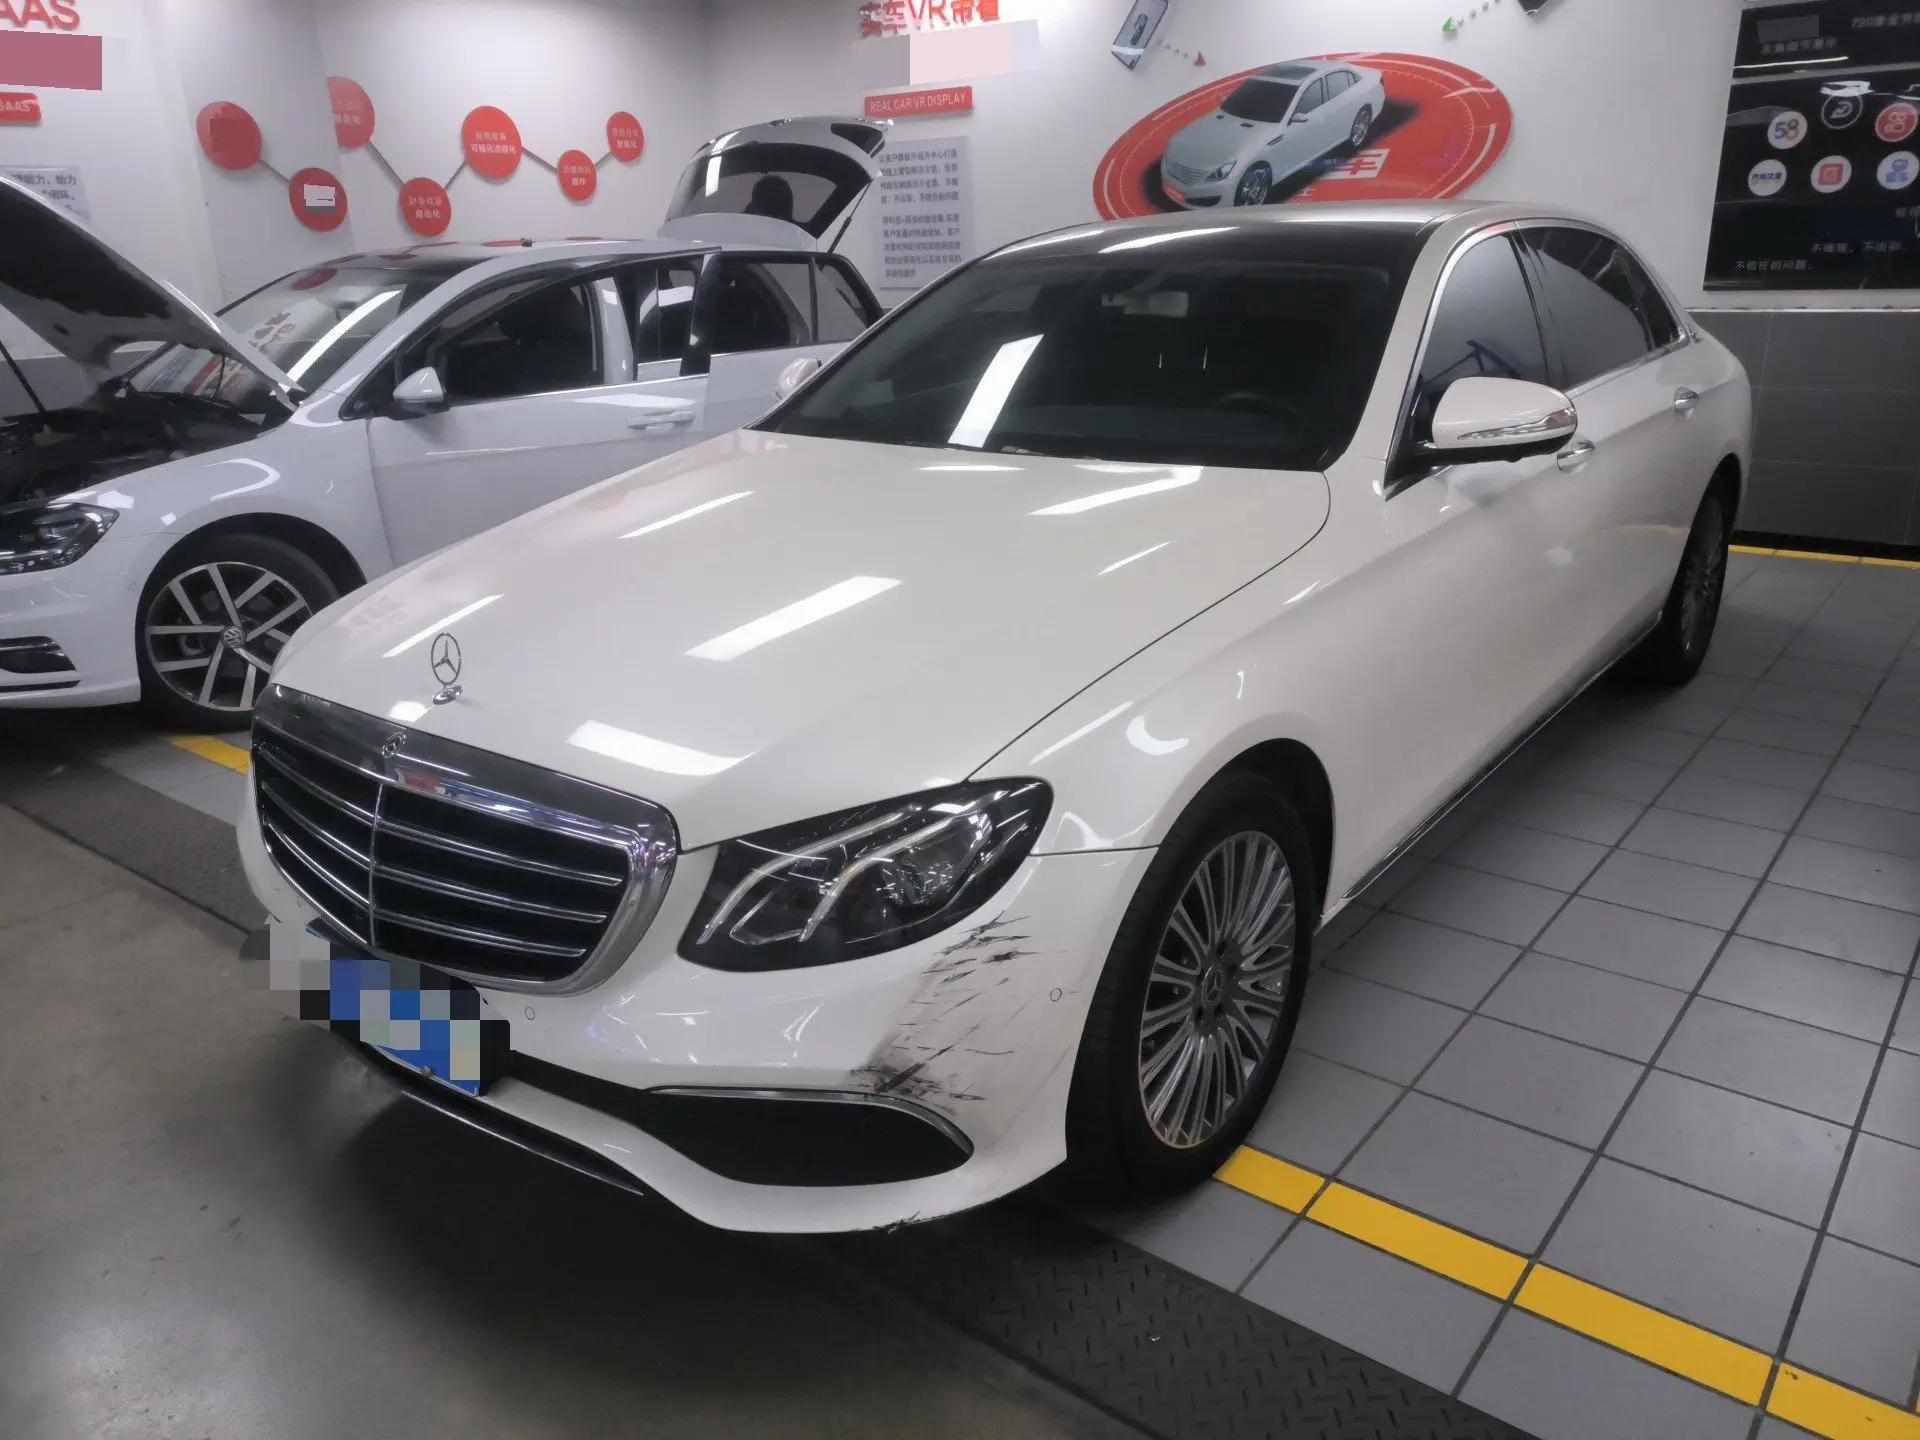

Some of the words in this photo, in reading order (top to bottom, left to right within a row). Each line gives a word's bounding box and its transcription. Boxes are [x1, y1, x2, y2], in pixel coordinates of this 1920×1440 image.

[870, 99, 892, 112] REAL
[893, 97, 912, 111] CAR
[913, 95, 926, 109] VR
[927, 92, 966, 107] DISPLAY
